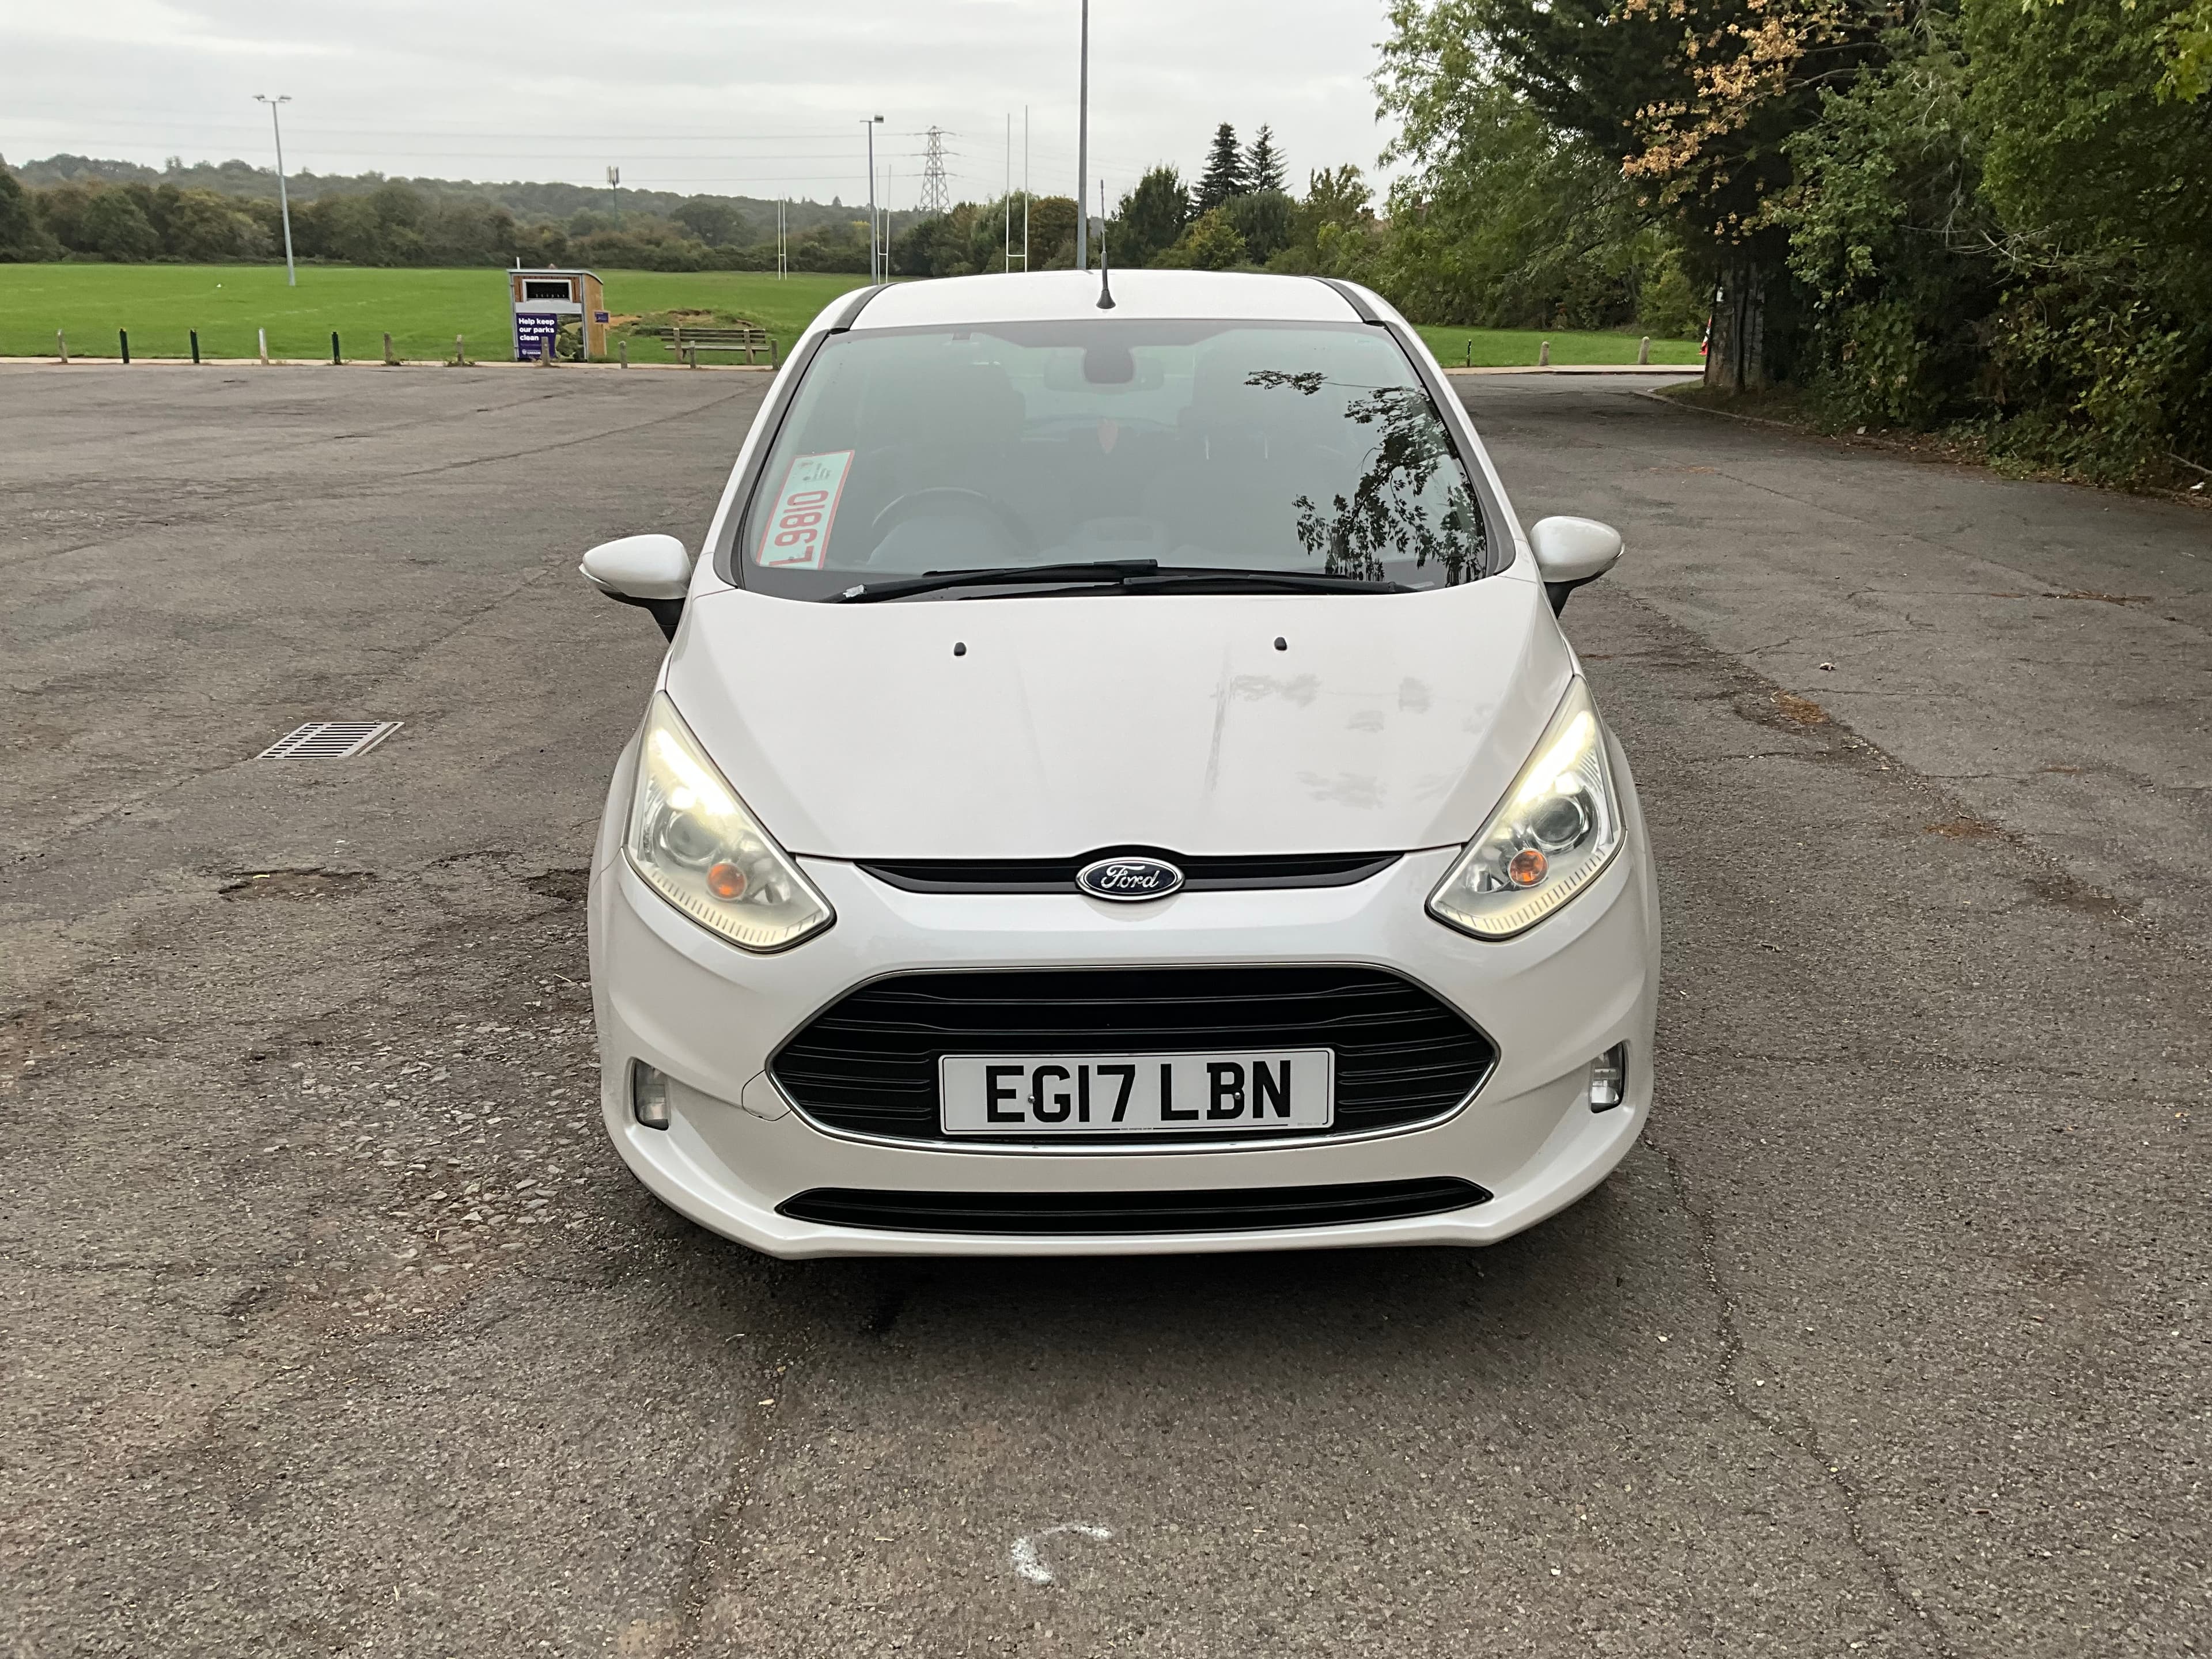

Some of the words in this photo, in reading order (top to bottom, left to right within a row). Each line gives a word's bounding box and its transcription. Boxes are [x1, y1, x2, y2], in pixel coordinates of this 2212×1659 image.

[1100, 865, 1160, 889] Ford
[985, 1064, 1136, 1123] EG17
[1160, 1060, 1291, 1121] LBN
